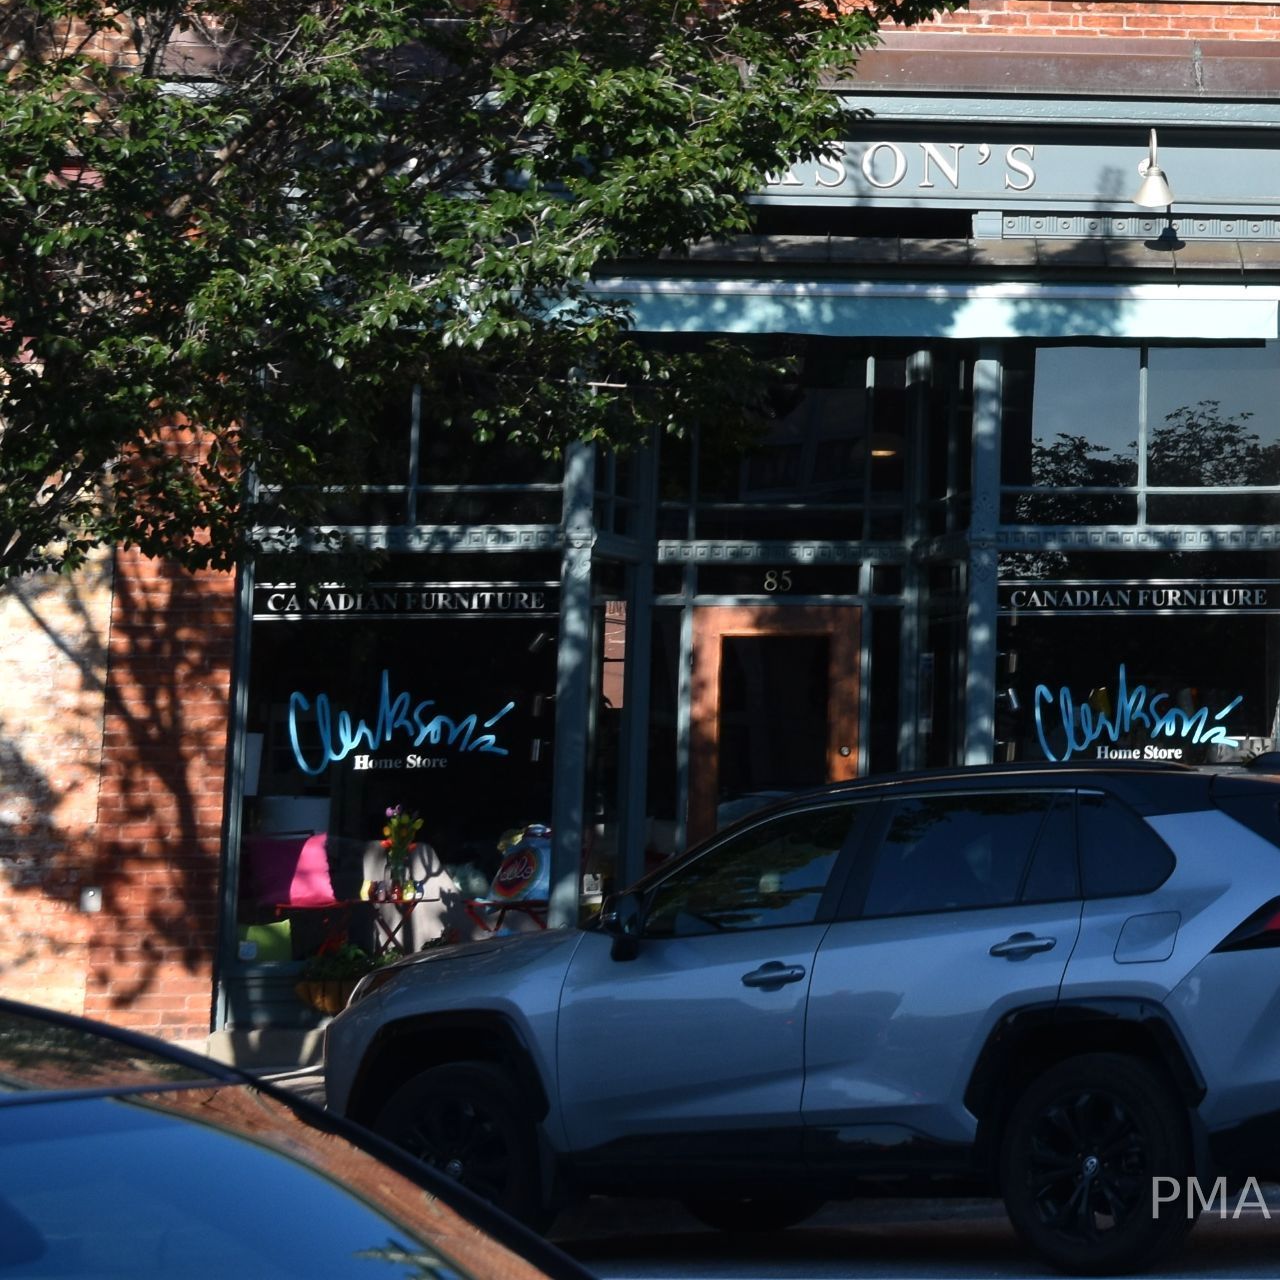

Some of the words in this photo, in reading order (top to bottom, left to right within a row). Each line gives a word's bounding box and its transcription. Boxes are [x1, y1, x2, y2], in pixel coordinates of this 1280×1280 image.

[763, 570, 792, 592] 85
[405, 592, 545, 610] FURNITURE
[1011, 590, 1130, 608] CANADIAN
[1139, 589, 1267, 606] FURNITURE
[1096, 746, 1140, 760] Home
[1143, 745, 1182, 760] Store
[354, 755, 401, 770] Home
[405, 754, 448, 769] Store
